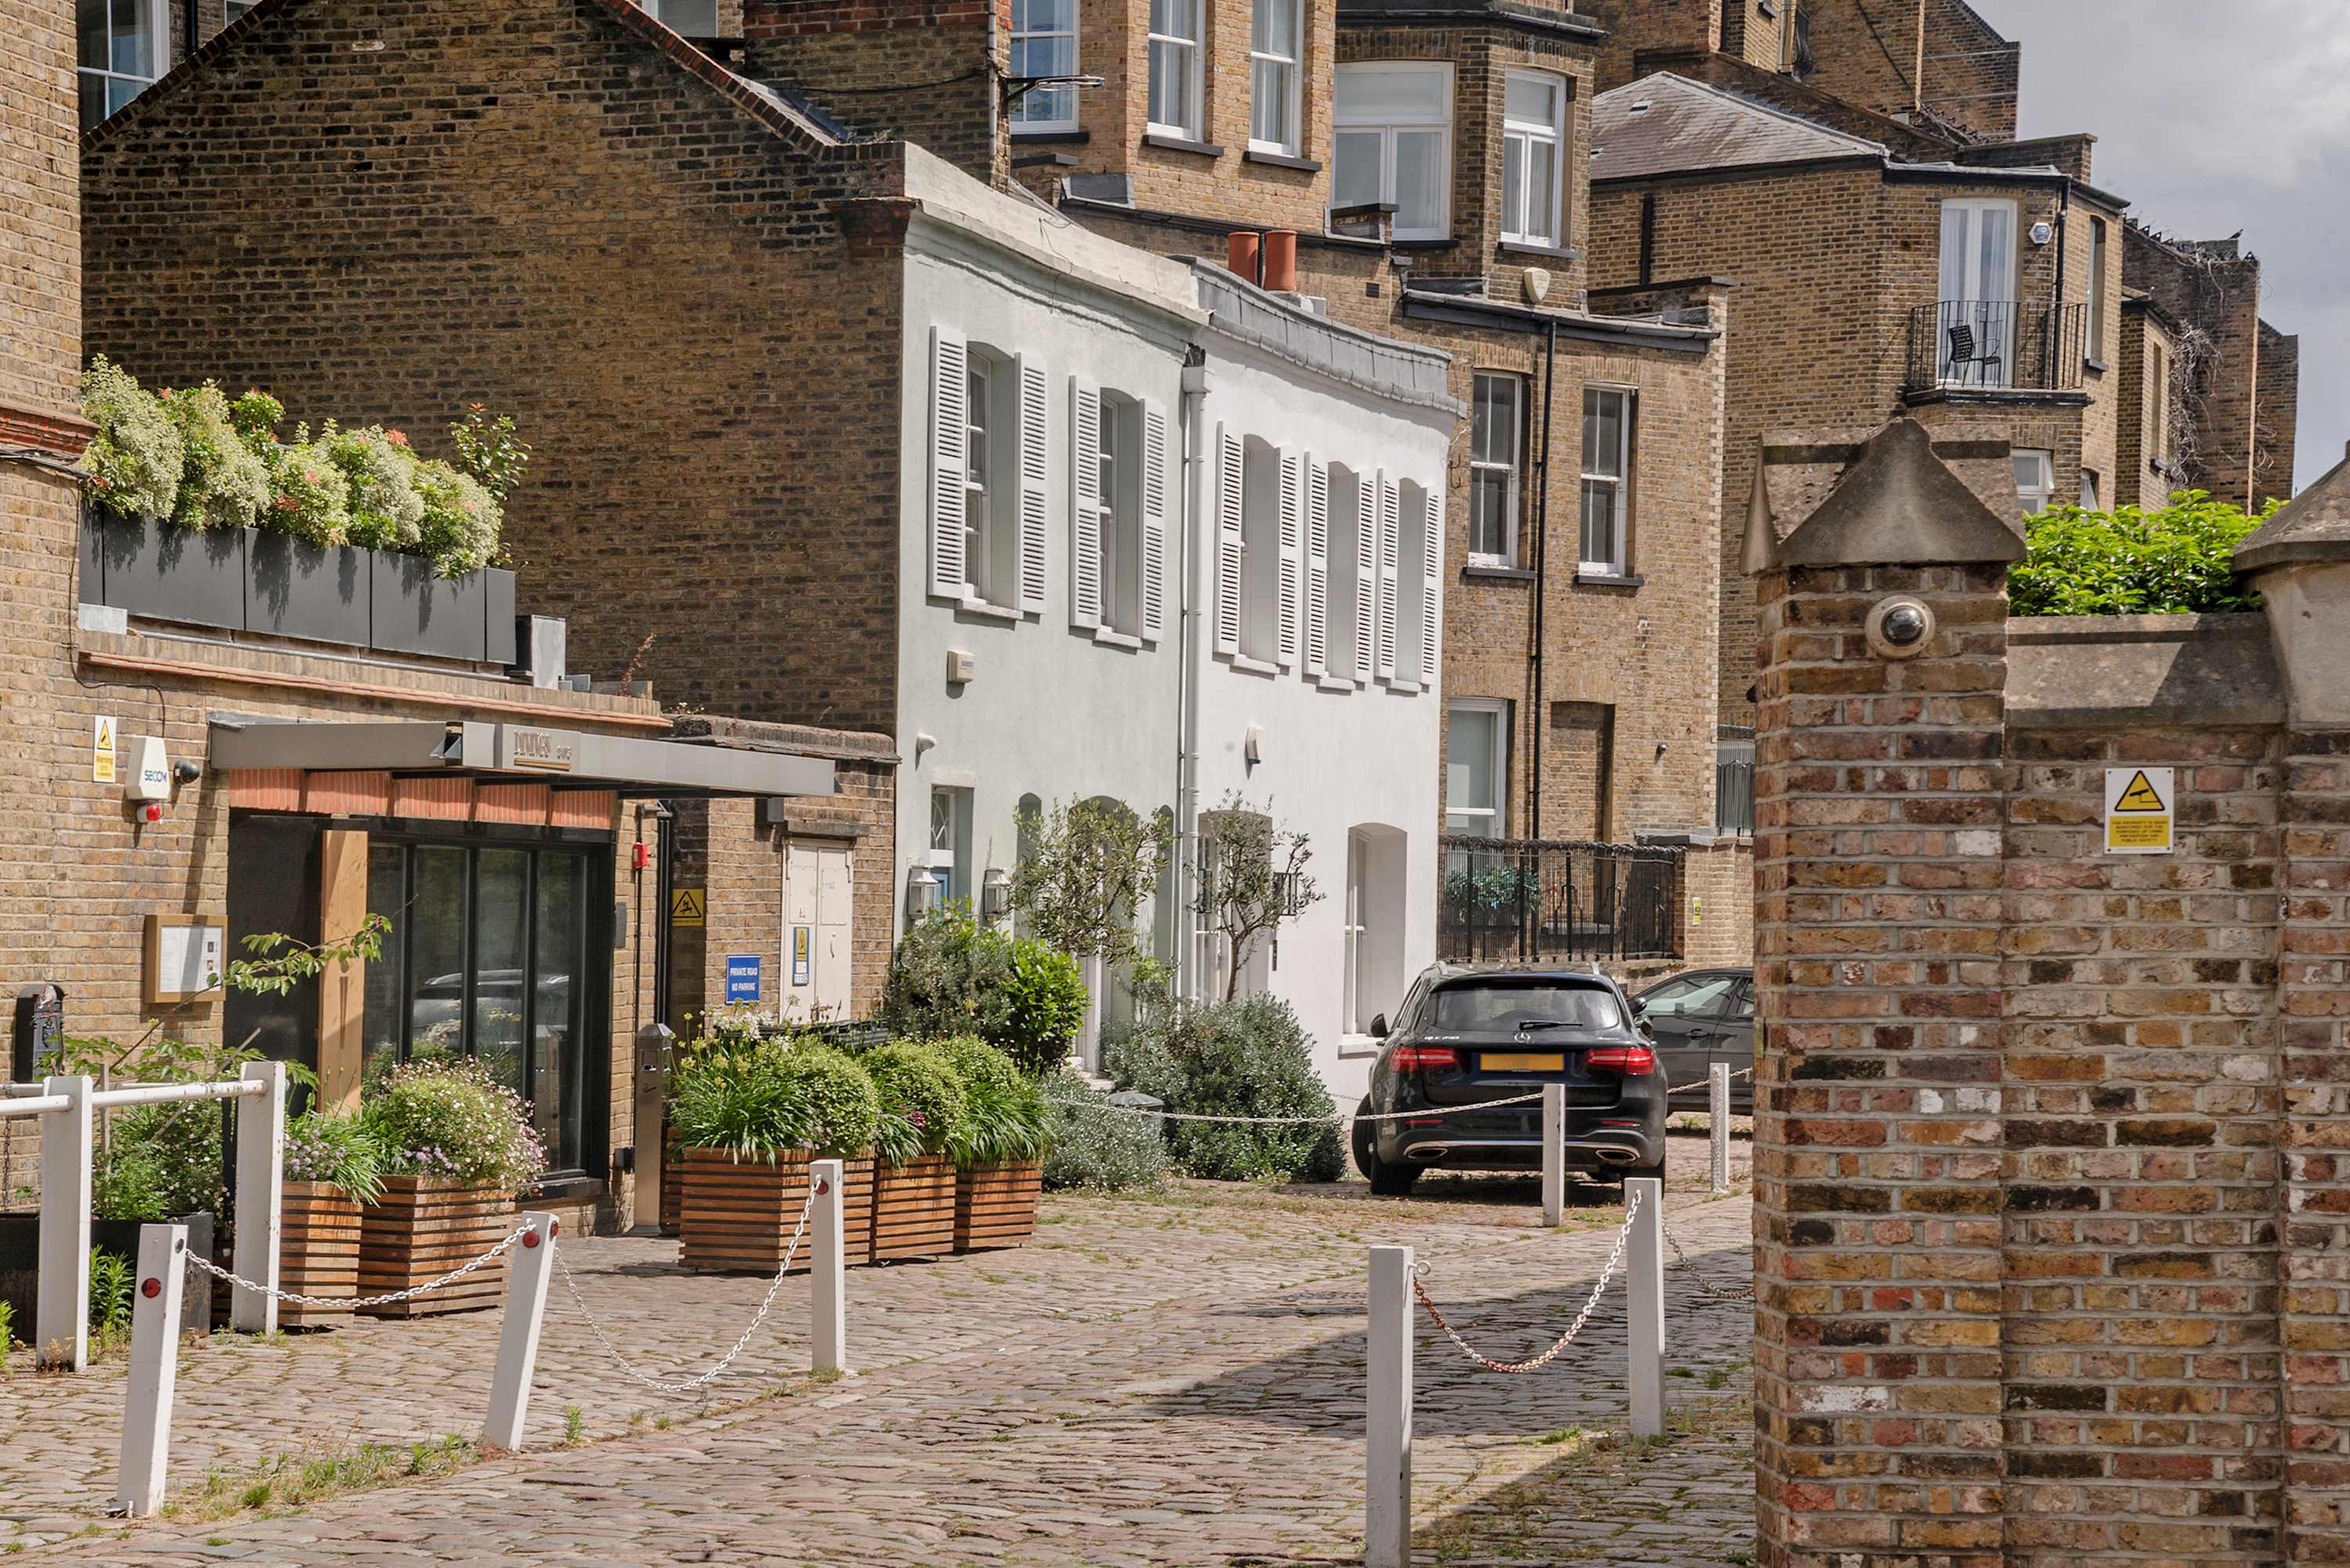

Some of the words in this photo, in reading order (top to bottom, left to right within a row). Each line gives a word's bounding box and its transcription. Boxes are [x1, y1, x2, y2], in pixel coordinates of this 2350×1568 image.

[144, 770, 167, 782] SECOM
[730, 966, 747, 977] PRIVATE
[747, 966, 758, 977] ROAD
[732, 982, 738, 992] NO
[739, 982, 756, 991] PARKING
